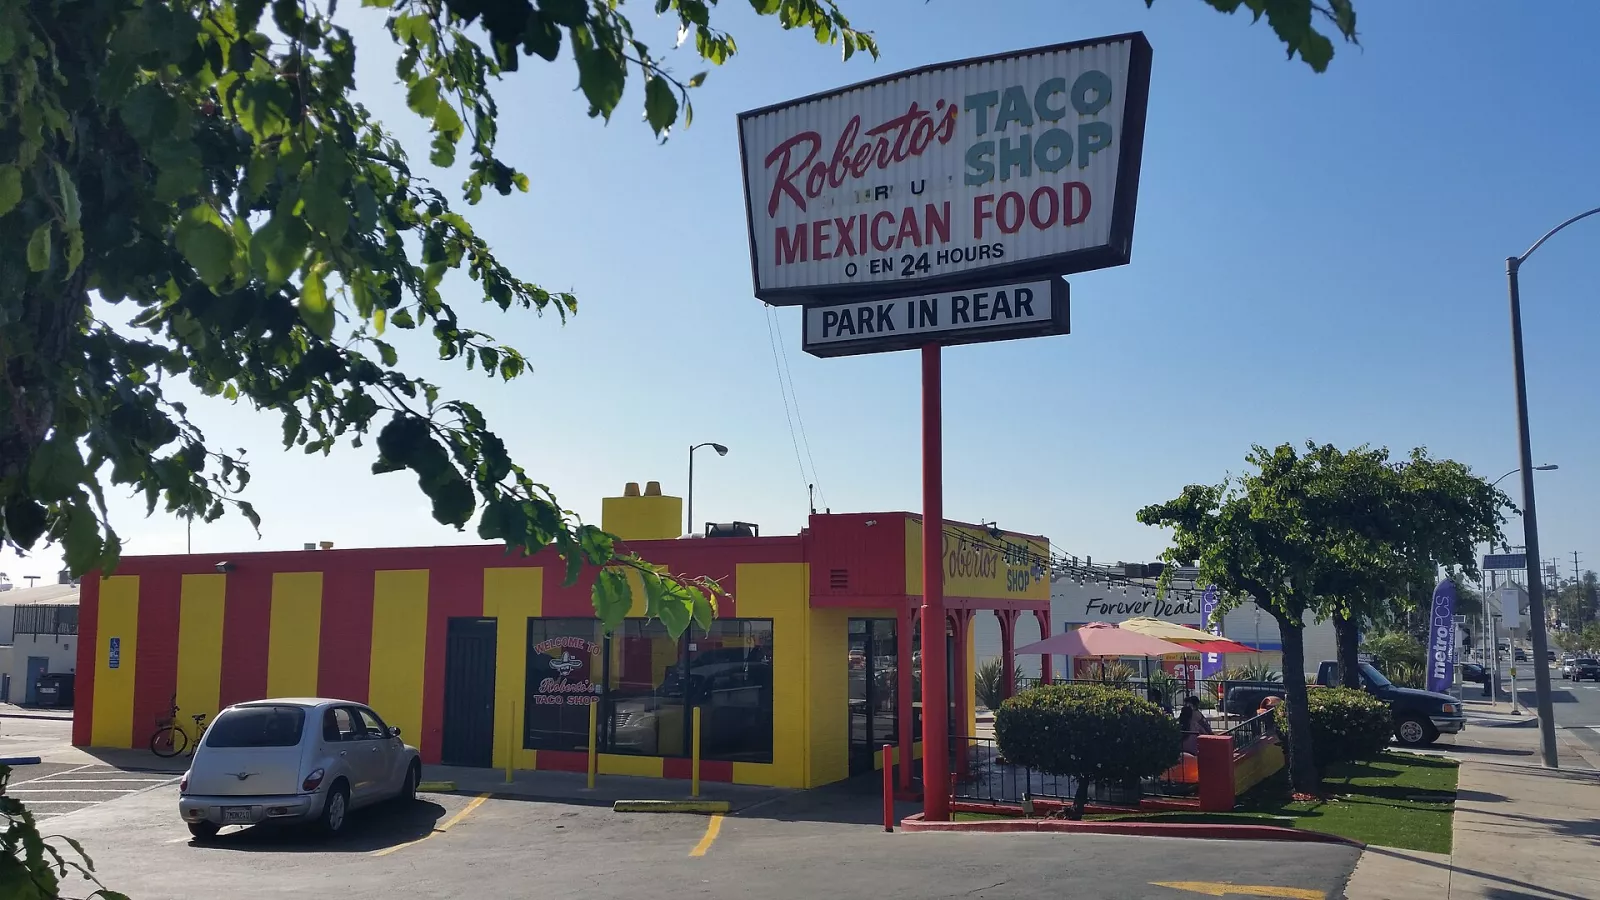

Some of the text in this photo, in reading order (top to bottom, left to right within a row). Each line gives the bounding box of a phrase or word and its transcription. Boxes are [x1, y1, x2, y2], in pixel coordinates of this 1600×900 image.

[964, 69, 1112, 136] TACO
[765, 98, 958, 218] Roberto's
[964, 121, 1112, 186] SHOP
[775, 181, 1092, 266] MEXICAN FOOD
[901, 252, 931, 276] 24
[937, 243, 1004, 265] HOURS
[822, 287, 1034, 338] PARK IN REAR
[1007, 569, 1029, 592] SHOP
[1086, 598, 1152, 615] Forever
[533, 636, 601, 656] WELCOME TO
[1434, 596, 1450, 679] metroPCS
[533, 694, 600, 705] TACO SHOP
[538, 678, 594, 693] Roberto's
